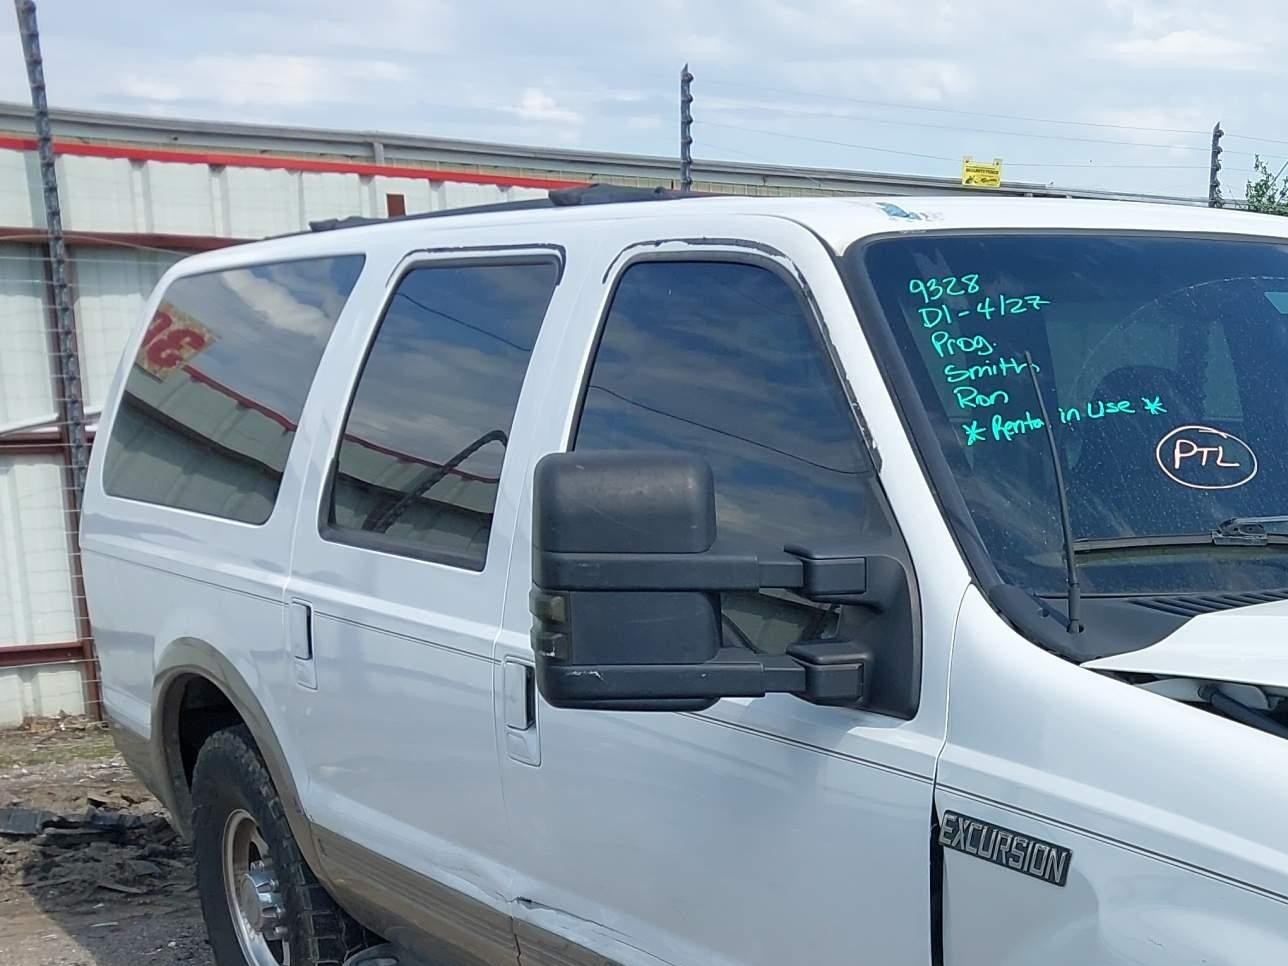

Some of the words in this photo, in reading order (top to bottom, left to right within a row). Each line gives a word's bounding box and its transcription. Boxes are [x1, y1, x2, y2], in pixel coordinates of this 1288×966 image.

[909, 273, 981, 304] 9328
[944, 356, 1041, 383] Smith
[953, 385, 1010, 409] Ron
[991, 410, 1048, 441] Renta
[1057, 407, 1081, 424] in
[1087, 399, 1137, 418] Use
[1174, 438, 1241, 470] PTL
[938, 813, 1068, 885] EXCURSION
